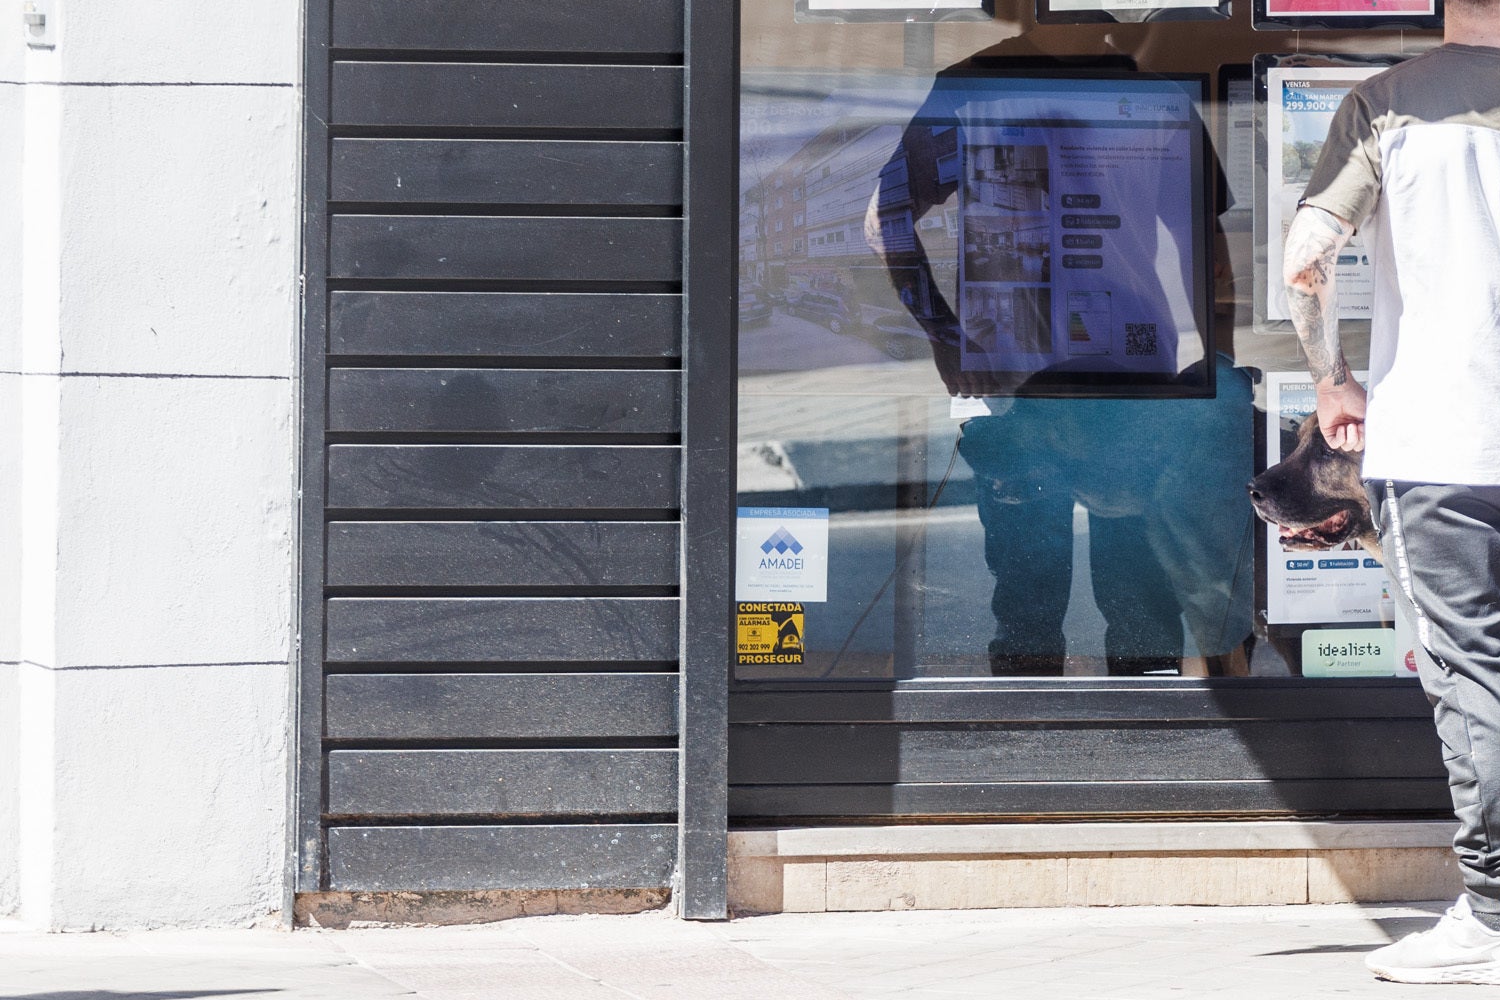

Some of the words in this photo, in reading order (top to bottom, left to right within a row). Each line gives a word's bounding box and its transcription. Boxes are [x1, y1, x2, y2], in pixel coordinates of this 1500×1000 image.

[1286, 101, 1326, 111] 299.900
[1327, 101, 1336, 110] €
[783, 509, 817, 517] ASOCIADA
[759, 558, 804, 570] AMADEI
[739, 602, 802, 612] CONECTADA
[1317, 642, 1381, 657] idealista
[738, 654, 802, 664] PROSEGUR
